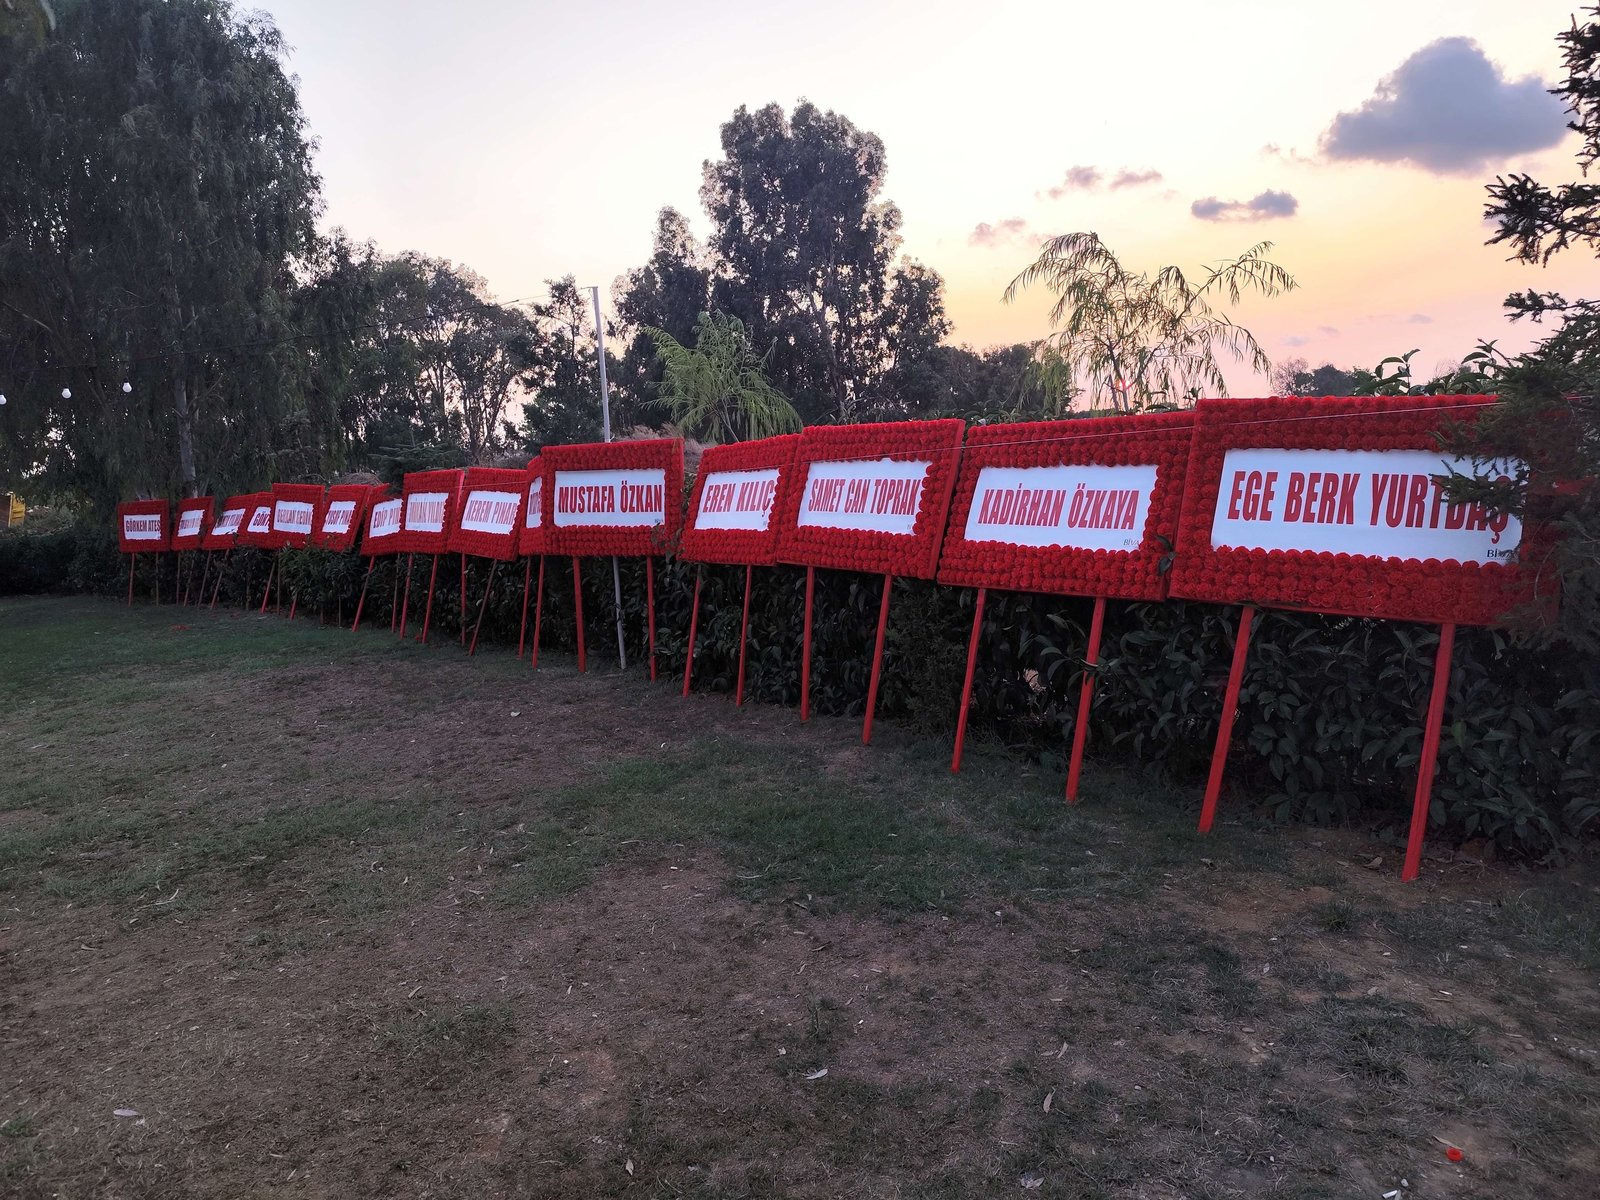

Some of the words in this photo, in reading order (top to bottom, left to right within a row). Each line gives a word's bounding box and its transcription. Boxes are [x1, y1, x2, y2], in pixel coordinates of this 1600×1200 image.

[465, 500, 493, 523] KEREM
[558, 486, 615, 513] MUSTAFA
[620, 480, 662, 513] ÖZKAN
[702, 483, 736, 513] EREN
[735, 480, 775, 518] KILIÇ
[808, 479, 846, 513] SAMET
[844, 479, 872, 513] CAN
[869, 479, 922, 515] TOPRAK
[978, 483, 1067, 527] KADİRHAN
[1067, 483, 1139, 530] ÖZKAYA
[1227, 470, 1278, 521] EGE
[1283, 472, 1360, 525] BERK
[126, 518, 147, 532] GÖRKEM
